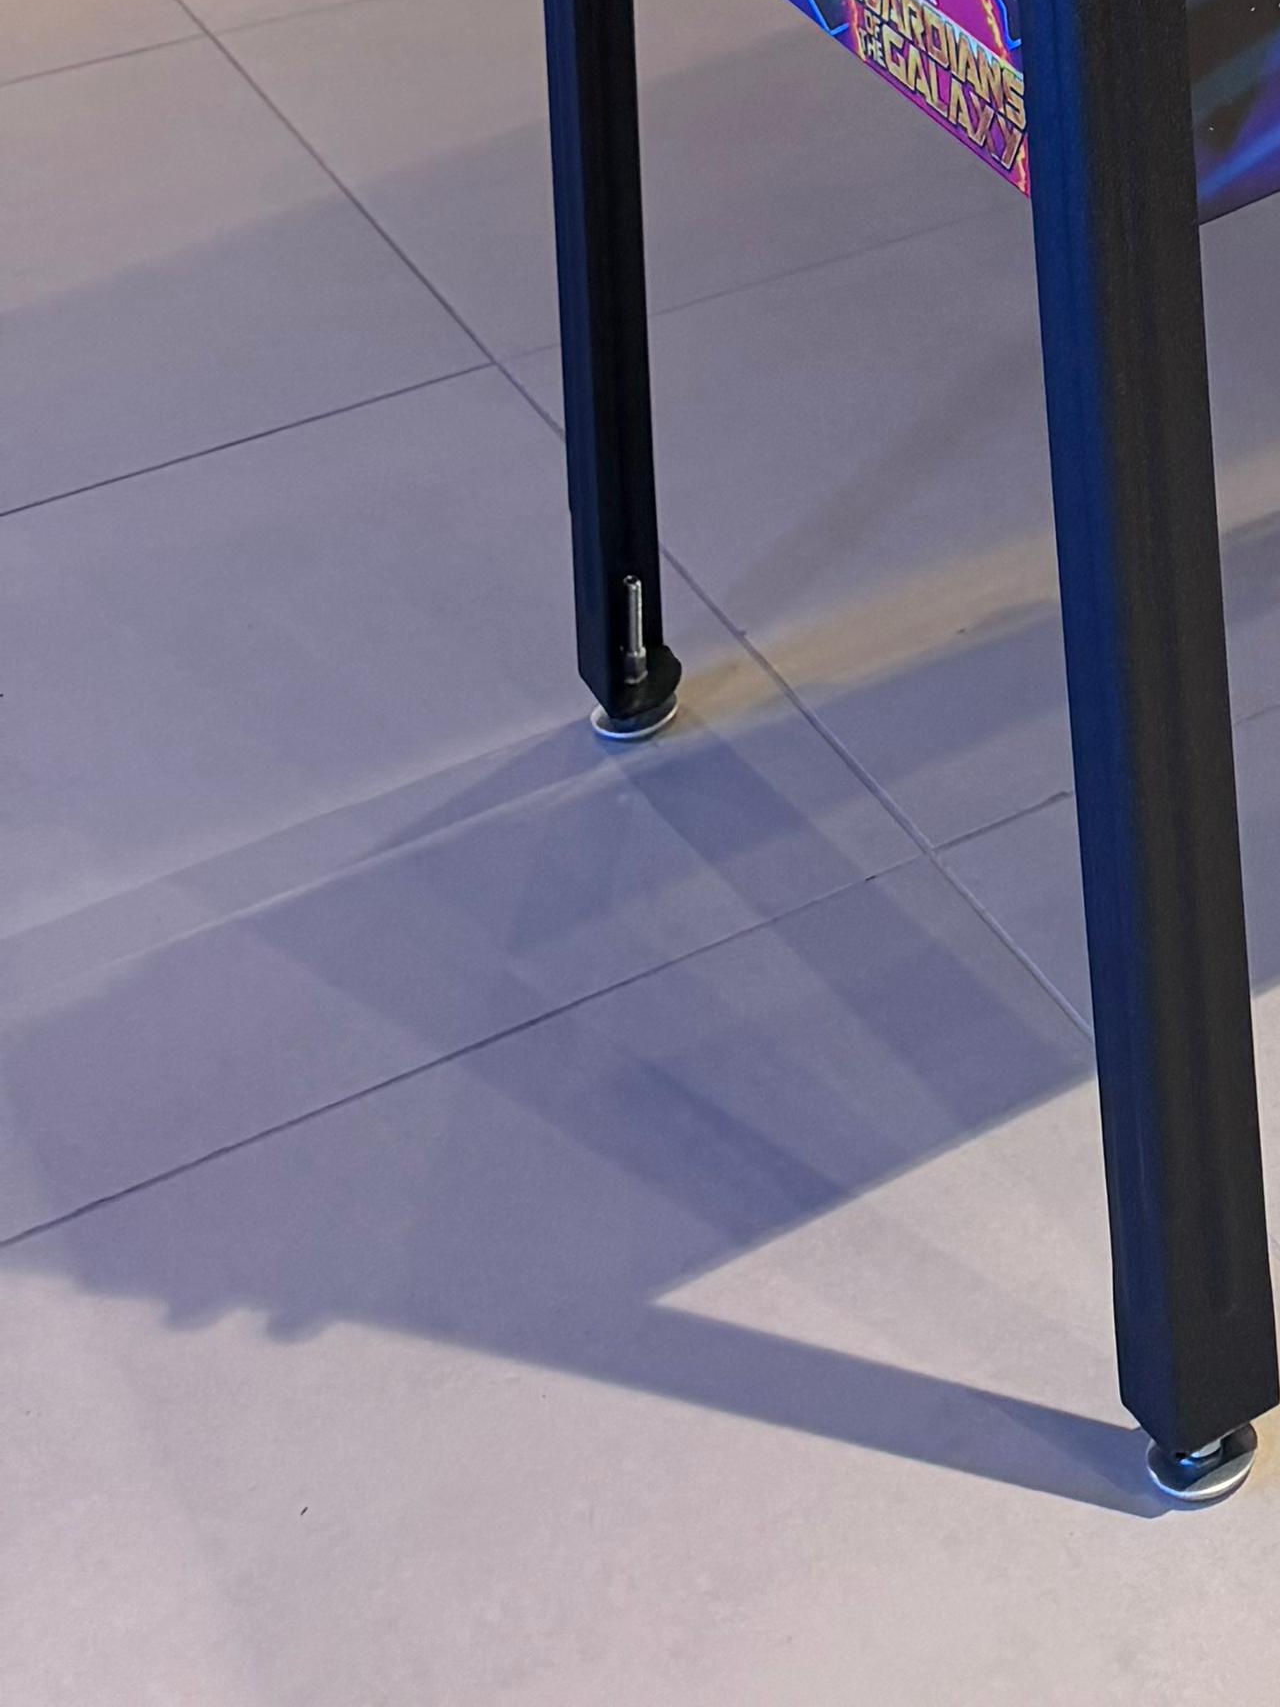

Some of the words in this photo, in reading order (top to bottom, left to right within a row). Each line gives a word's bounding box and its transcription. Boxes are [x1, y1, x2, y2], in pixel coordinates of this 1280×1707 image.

[863, 7, 882, 36] OF
[858, 25, 885, 68] THE
[882, 23, 1023, 172] GALAXY
